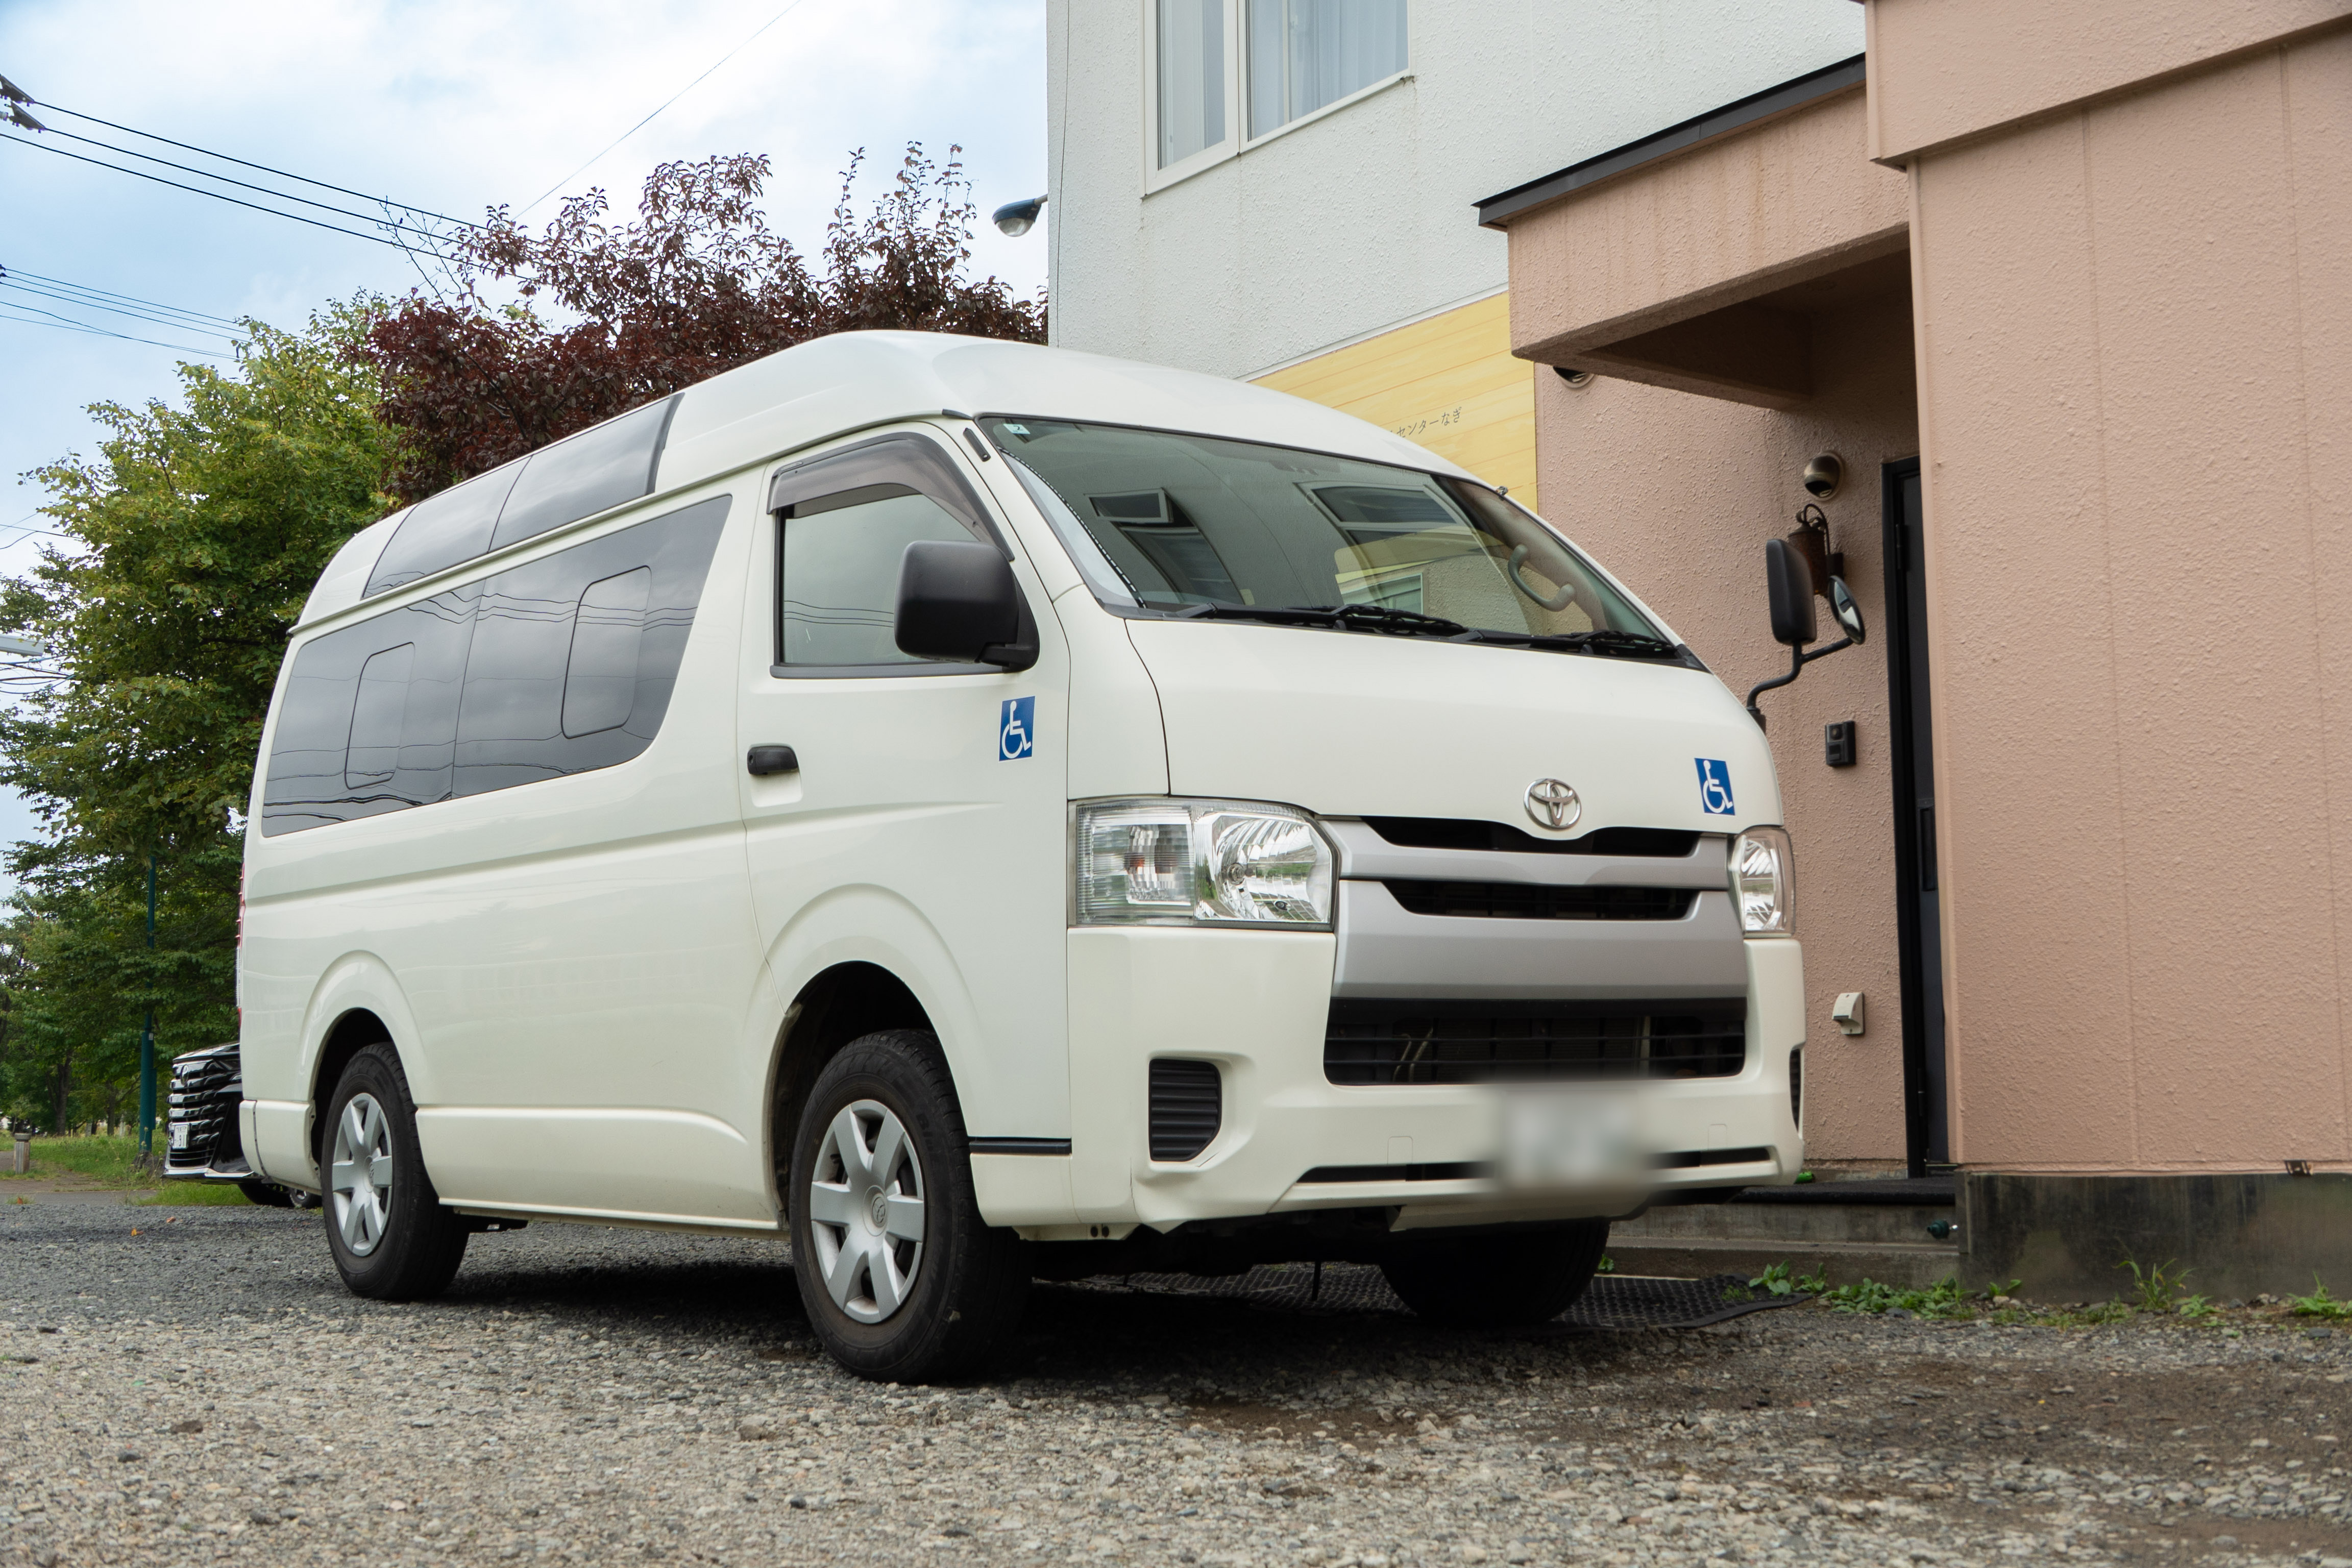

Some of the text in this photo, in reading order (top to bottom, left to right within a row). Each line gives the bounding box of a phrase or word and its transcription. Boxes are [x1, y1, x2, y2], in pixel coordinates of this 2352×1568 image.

[1390, 406, 1462, 438] センターなぎ
